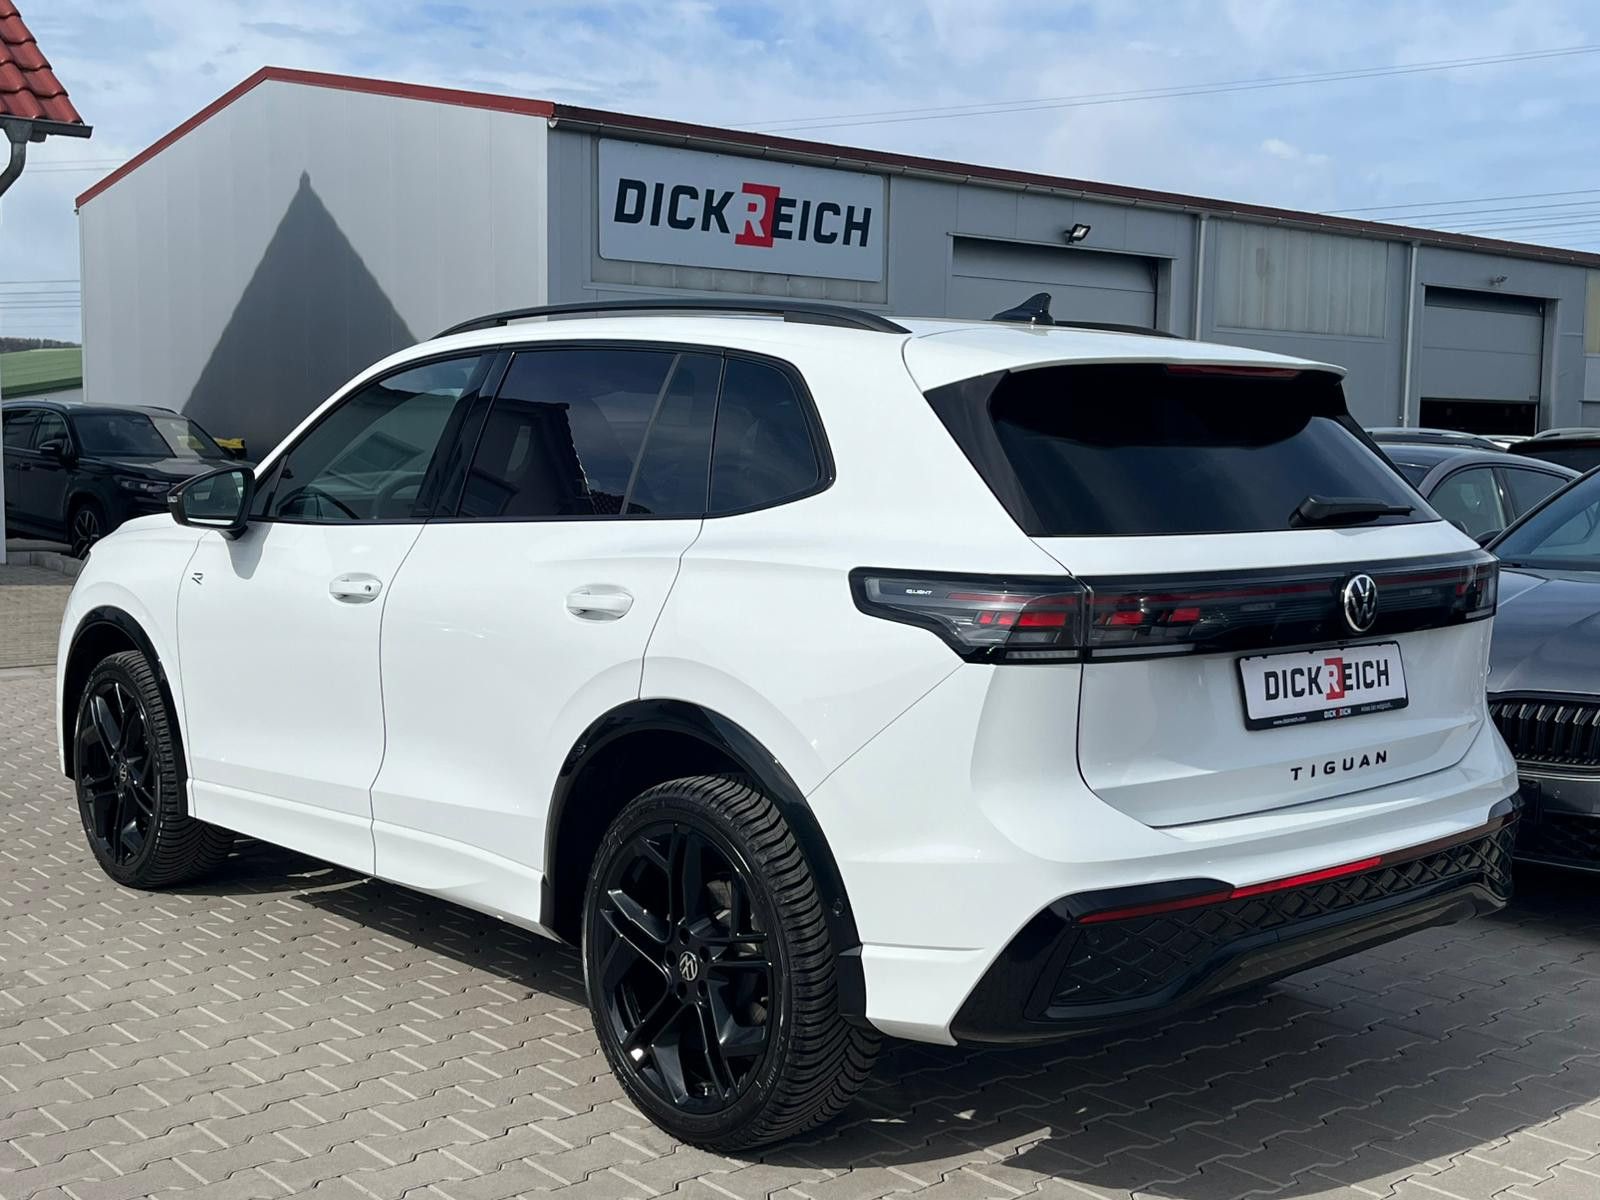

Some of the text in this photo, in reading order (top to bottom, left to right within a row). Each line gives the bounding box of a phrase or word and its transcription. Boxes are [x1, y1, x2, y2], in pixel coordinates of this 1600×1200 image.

[613, 177, 872, 248] DICKREICH
[1264, 657, 1390, 701] DICKREICH
[1290, 750, 1387, 781] TIGUAN
